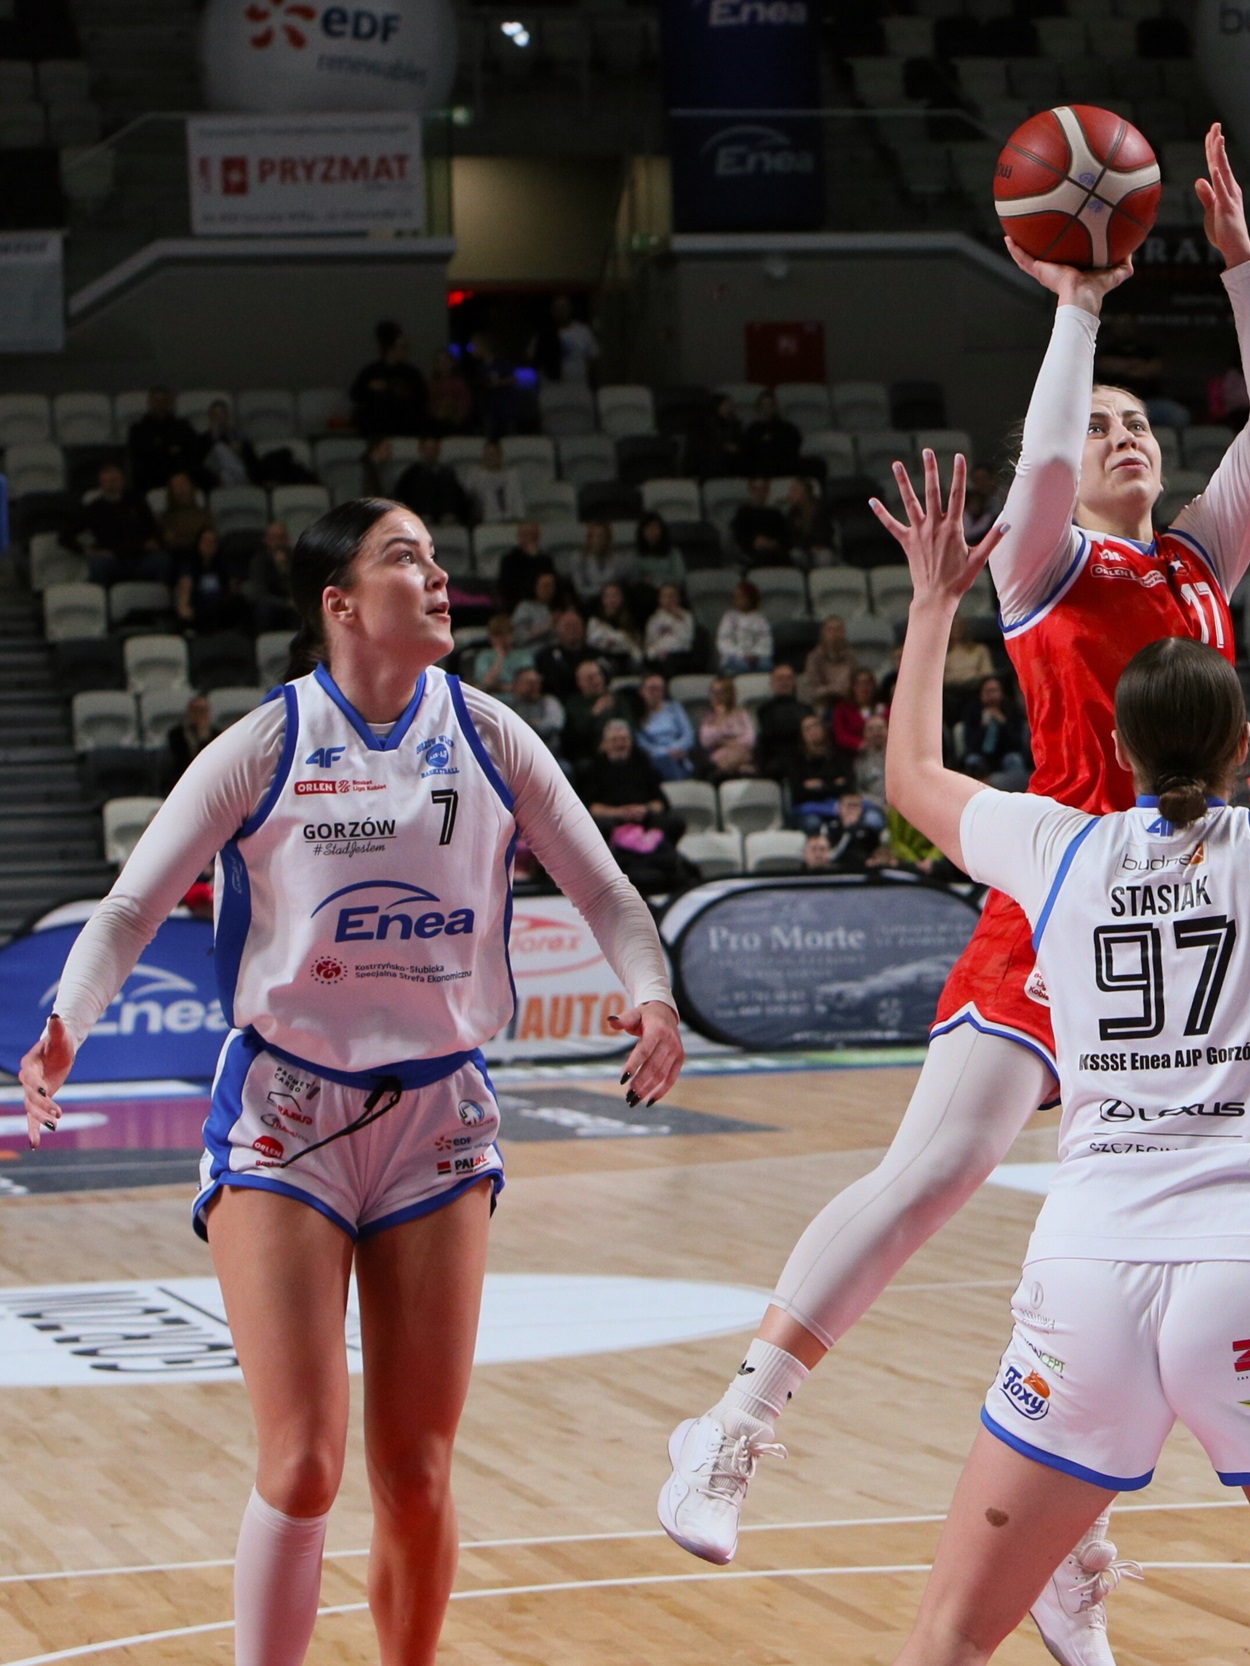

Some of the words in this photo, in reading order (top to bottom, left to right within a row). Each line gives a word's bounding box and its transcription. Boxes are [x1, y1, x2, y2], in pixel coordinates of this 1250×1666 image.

[708, 0, 808, 27] Enea
[257, 154, 409, 184] PRYZMAT
[714, 145, 815, 177] Enea
[1095, 566, 1128, 577] ORLEN
[305, 746, 346, 768] 4F
[297, 783, 334, 793] ORLEN
[303, 816, 396, 839] GORZÓW
[431, 789, 458, 846] 7
[1111, 875, 1212, 917] STASIAK
[335, 905, 475, 943] Enea
[708, 926, 761, 951] Pro
[770, 925, 866, 950] Morte
[355, 970, 397, 978] Specjalna
[399, 973, 425, 983] Strefa
[1094, 915, 1236, 1041] 97
[1079, 1053, 1127, 1072] KSSSE
[1131, 1050, 1171, 1071] Enea
[1175, 1048, 1202, 1068] AJP
[274, 1073, 301, 1093] CARGO
[277, 1067, 311, 1089] PROMET
[254, 1142, 282, 1157] ORLEN
[1003, 1366, 1046, 1416] Foxy
